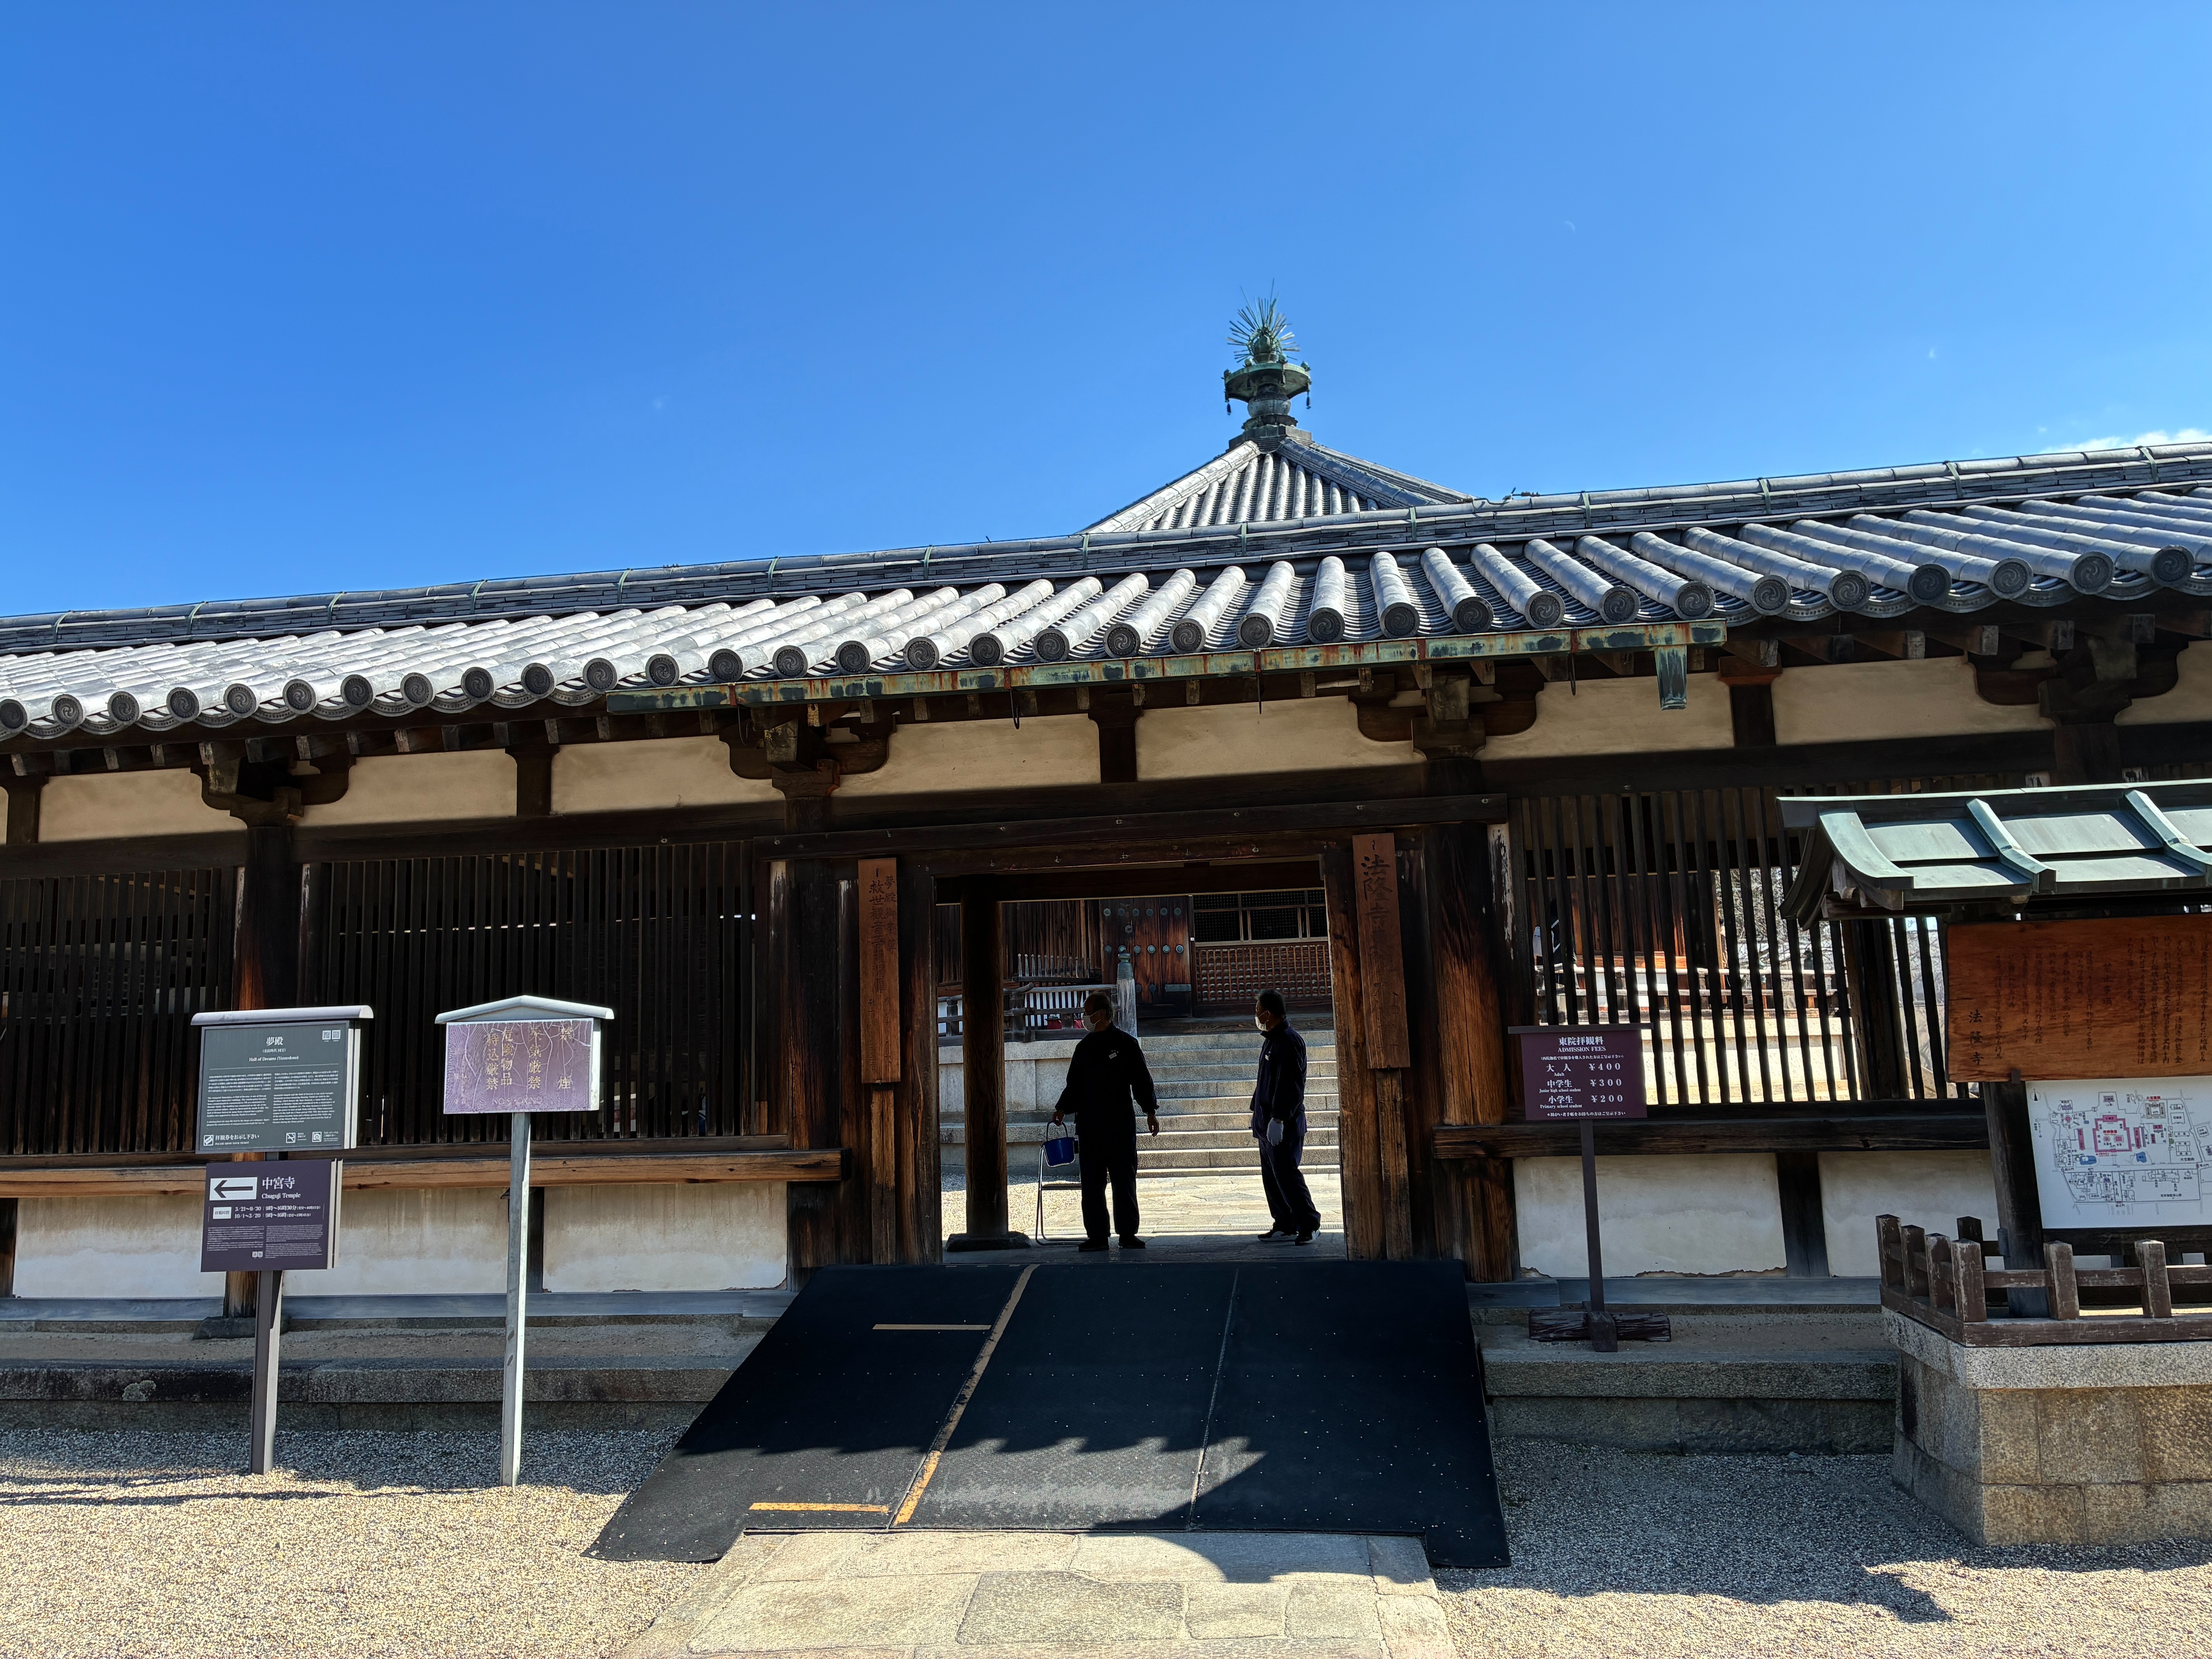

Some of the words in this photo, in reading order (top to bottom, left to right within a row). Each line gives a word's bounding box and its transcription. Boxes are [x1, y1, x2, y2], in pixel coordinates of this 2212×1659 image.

[1559, 1036, 1604, 1046] 東院拝観料
[1968, 1009, 1984, 1066] 法隆寺
[1547, 1079, 1573, 1088] 中学生
[1548, 1095, 1573, 1104] 小学生
[262, 1176, 295, 1190] 中宮寺
